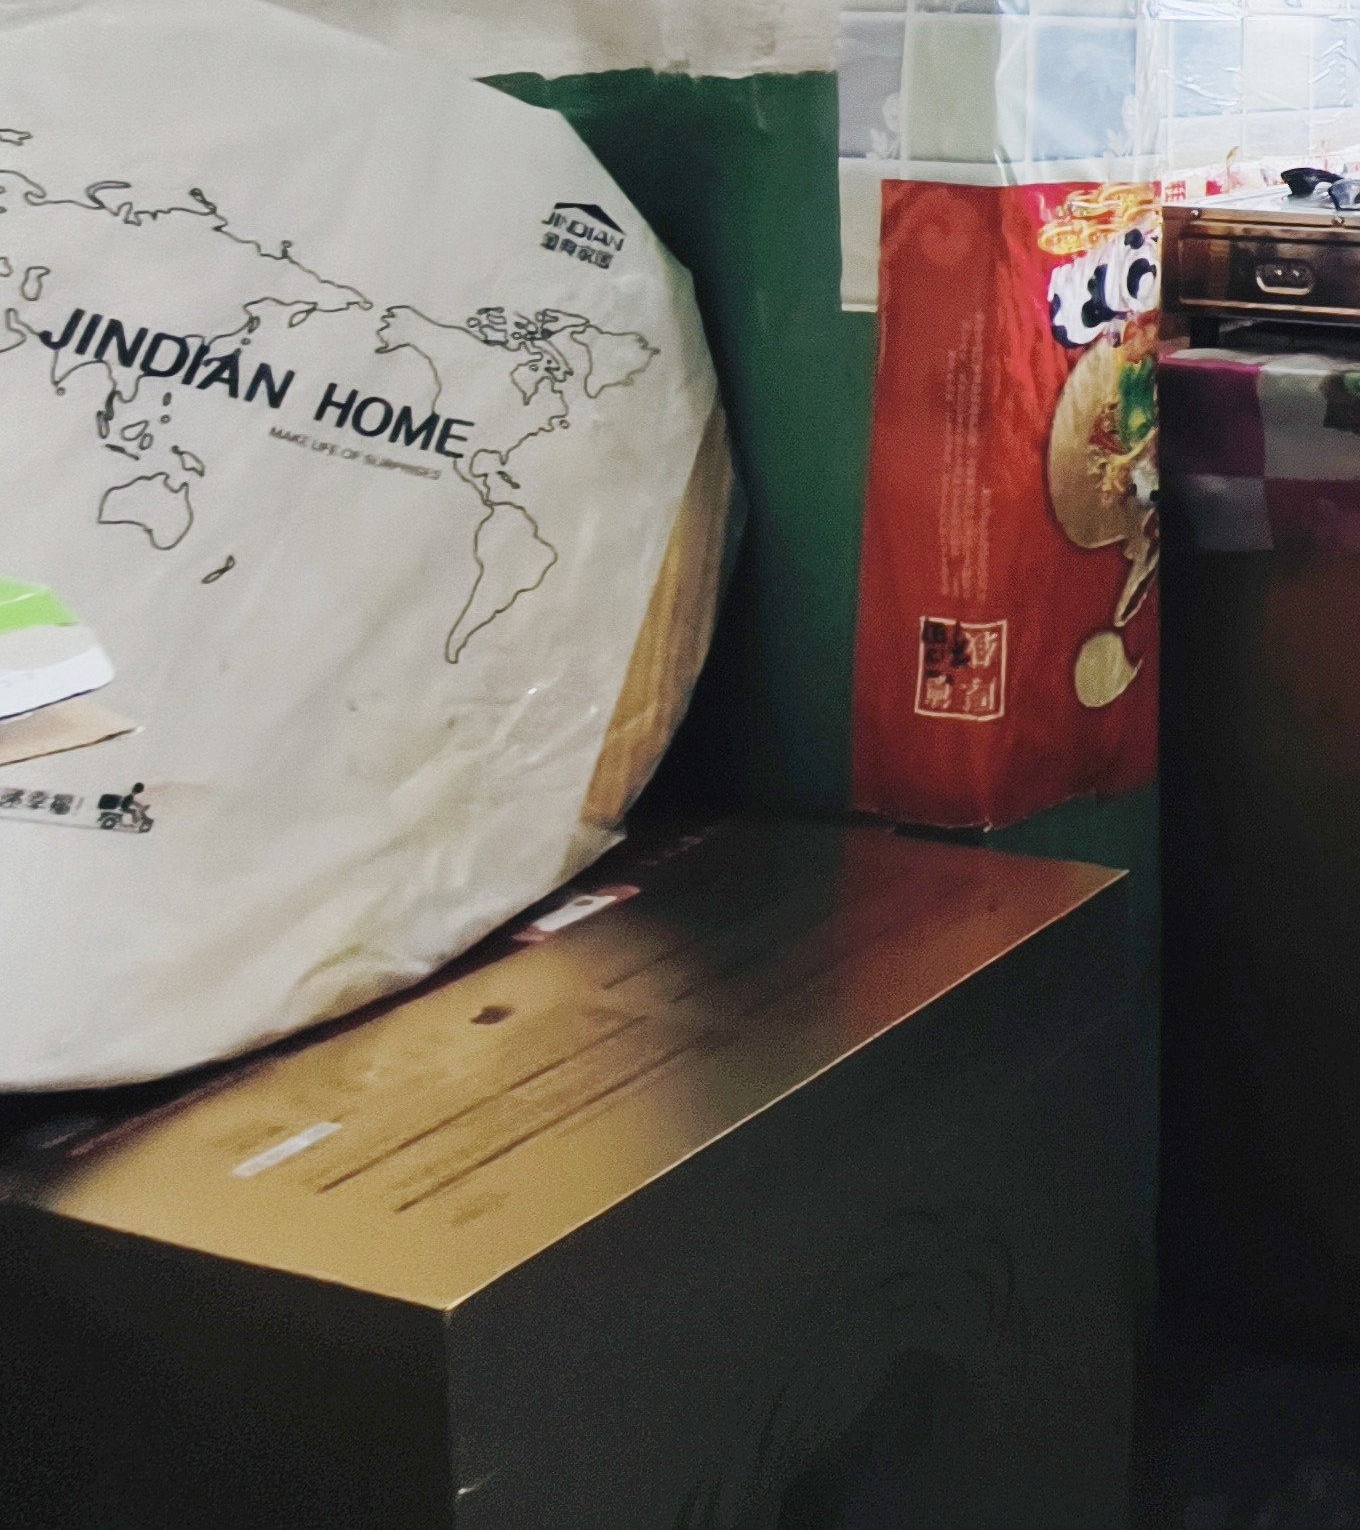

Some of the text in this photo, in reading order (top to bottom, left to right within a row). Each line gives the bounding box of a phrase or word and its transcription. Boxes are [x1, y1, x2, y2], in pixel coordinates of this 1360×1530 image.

[541, 211, 625, 251] JINDIAN
[38, 307, 475, 458] JINDIAN HOME
